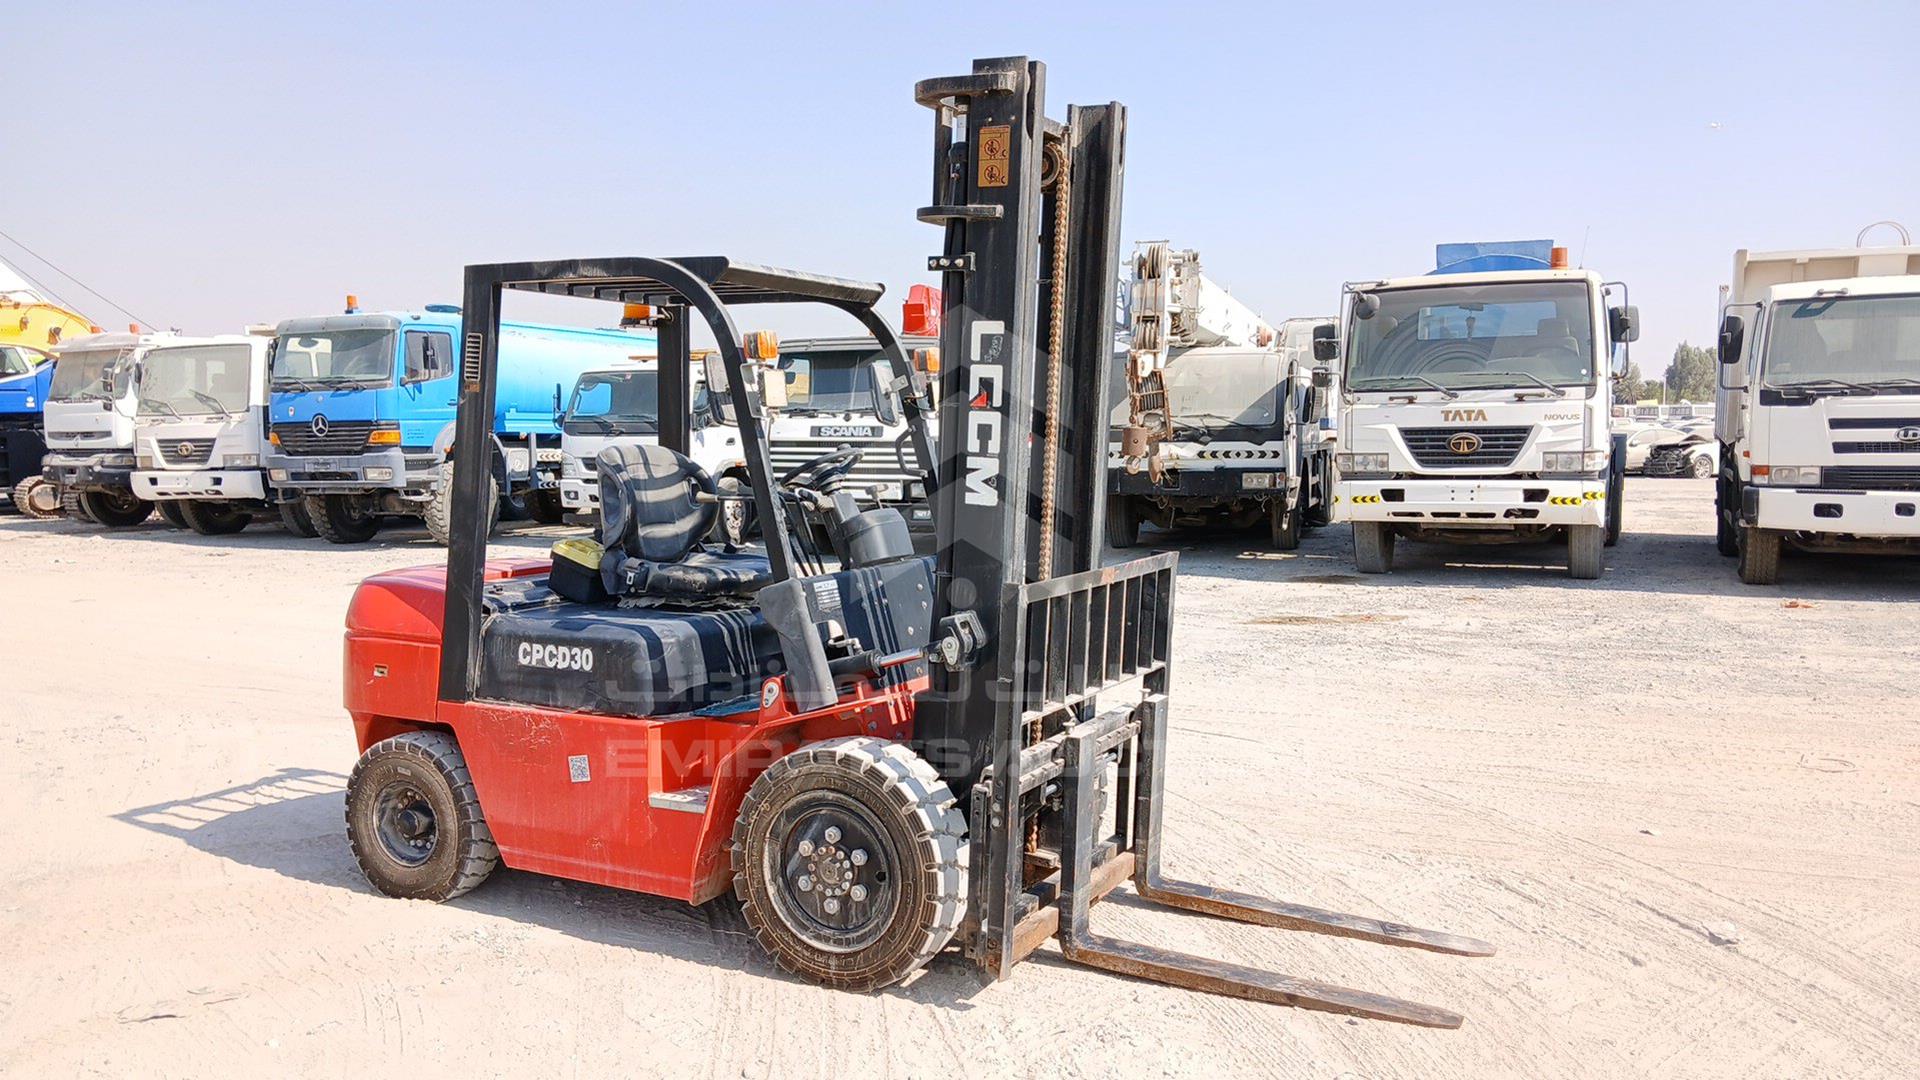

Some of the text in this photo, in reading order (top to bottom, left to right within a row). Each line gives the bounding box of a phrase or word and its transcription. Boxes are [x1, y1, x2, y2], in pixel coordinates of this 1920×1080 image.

[1441, 409, 1488, 422] TATA
[1543, 413, 1581, 421] NOVUS
[820, 426, 873, 437] SCANIA
[518, 641, 593, 671] CPCD30
